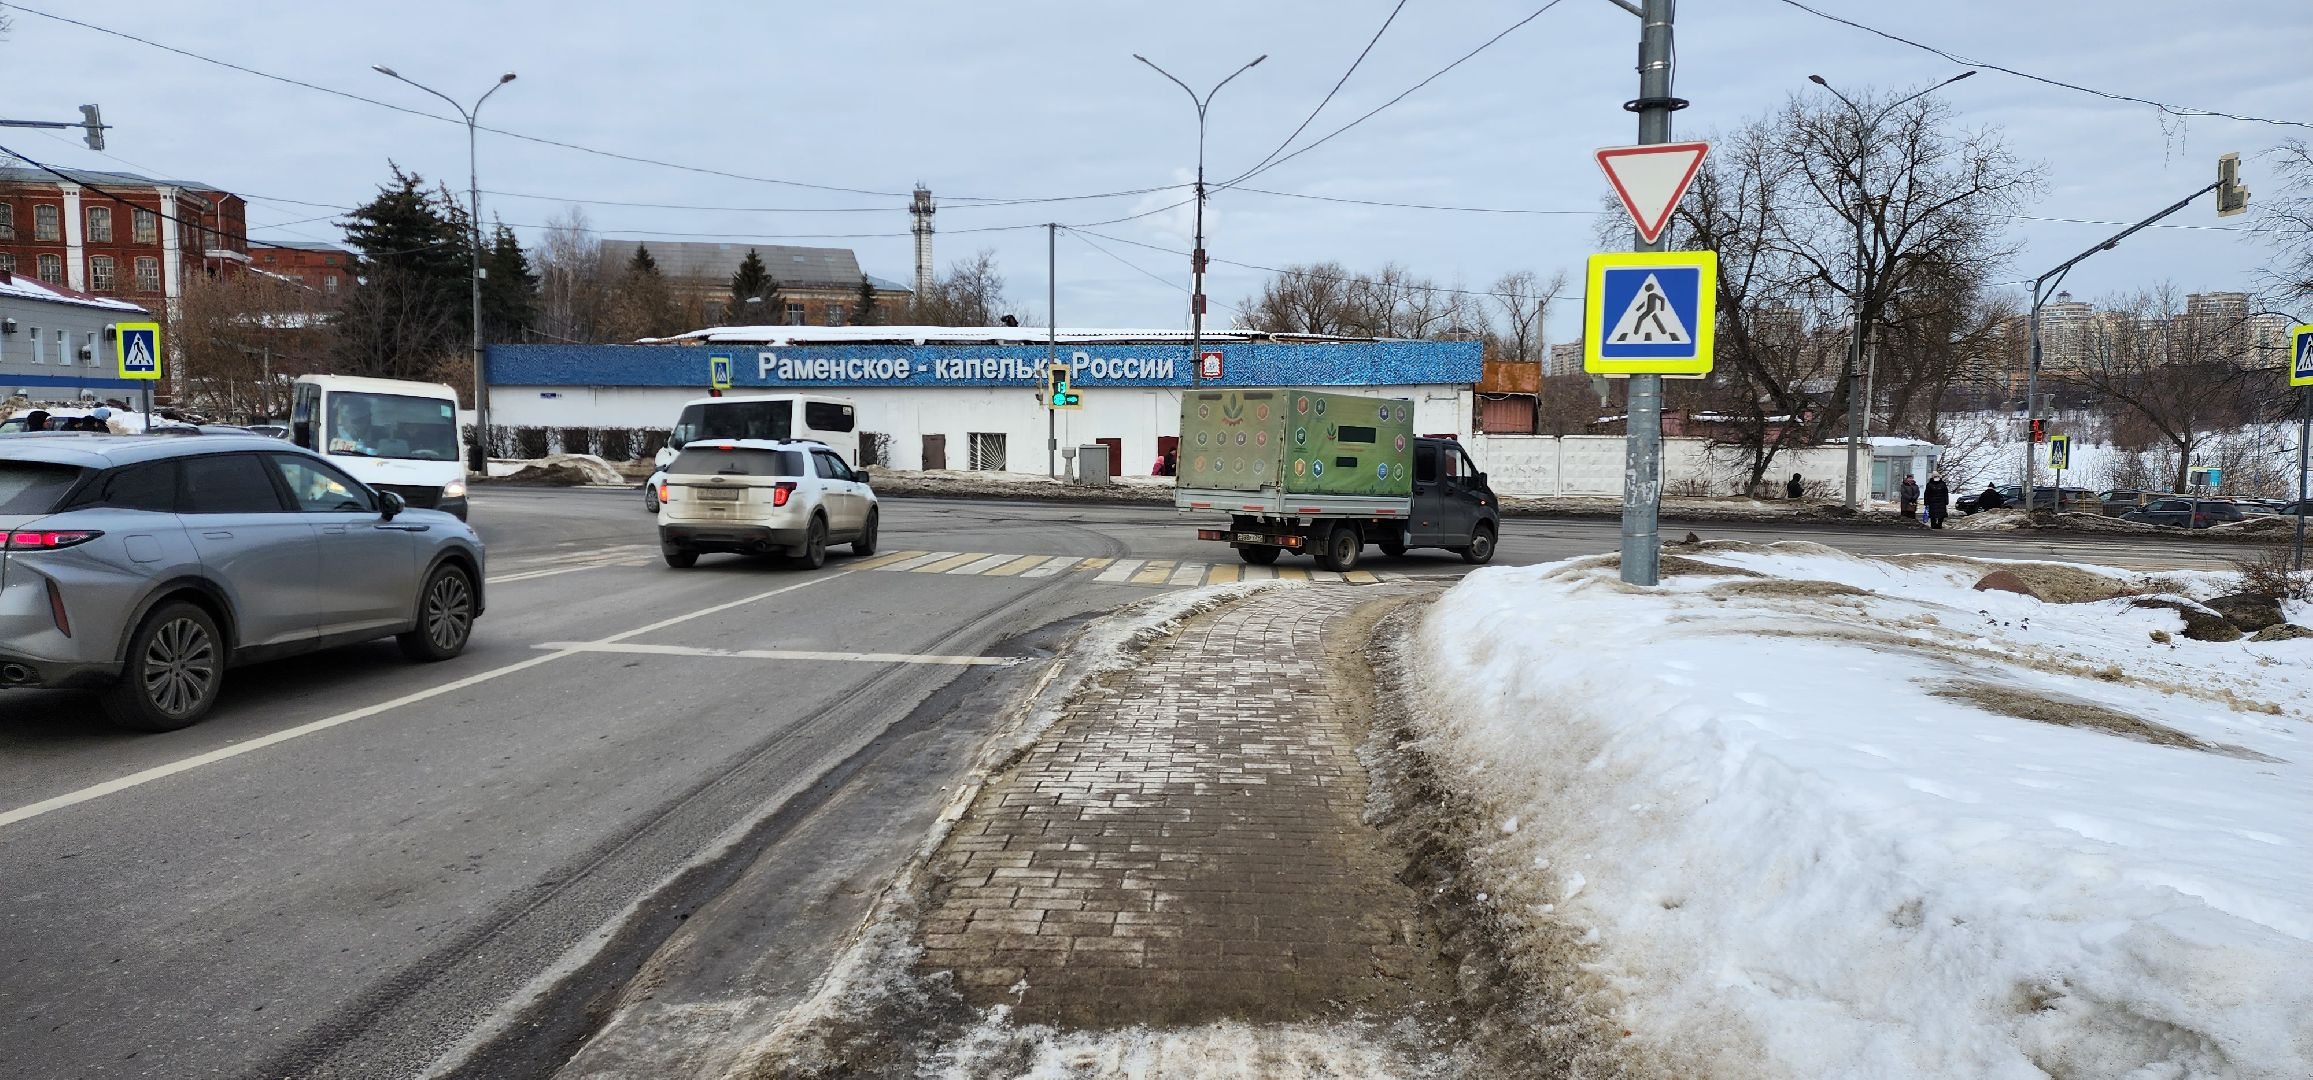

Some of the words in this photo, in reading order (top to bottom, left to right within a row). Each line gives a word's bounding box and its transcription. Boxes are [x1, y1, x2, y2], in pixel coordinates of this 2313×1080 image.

[758, 352, 910, 380] Раменское
[935, 358, 1062, 380] капельк
[1072, 351, 1174, 379] России
